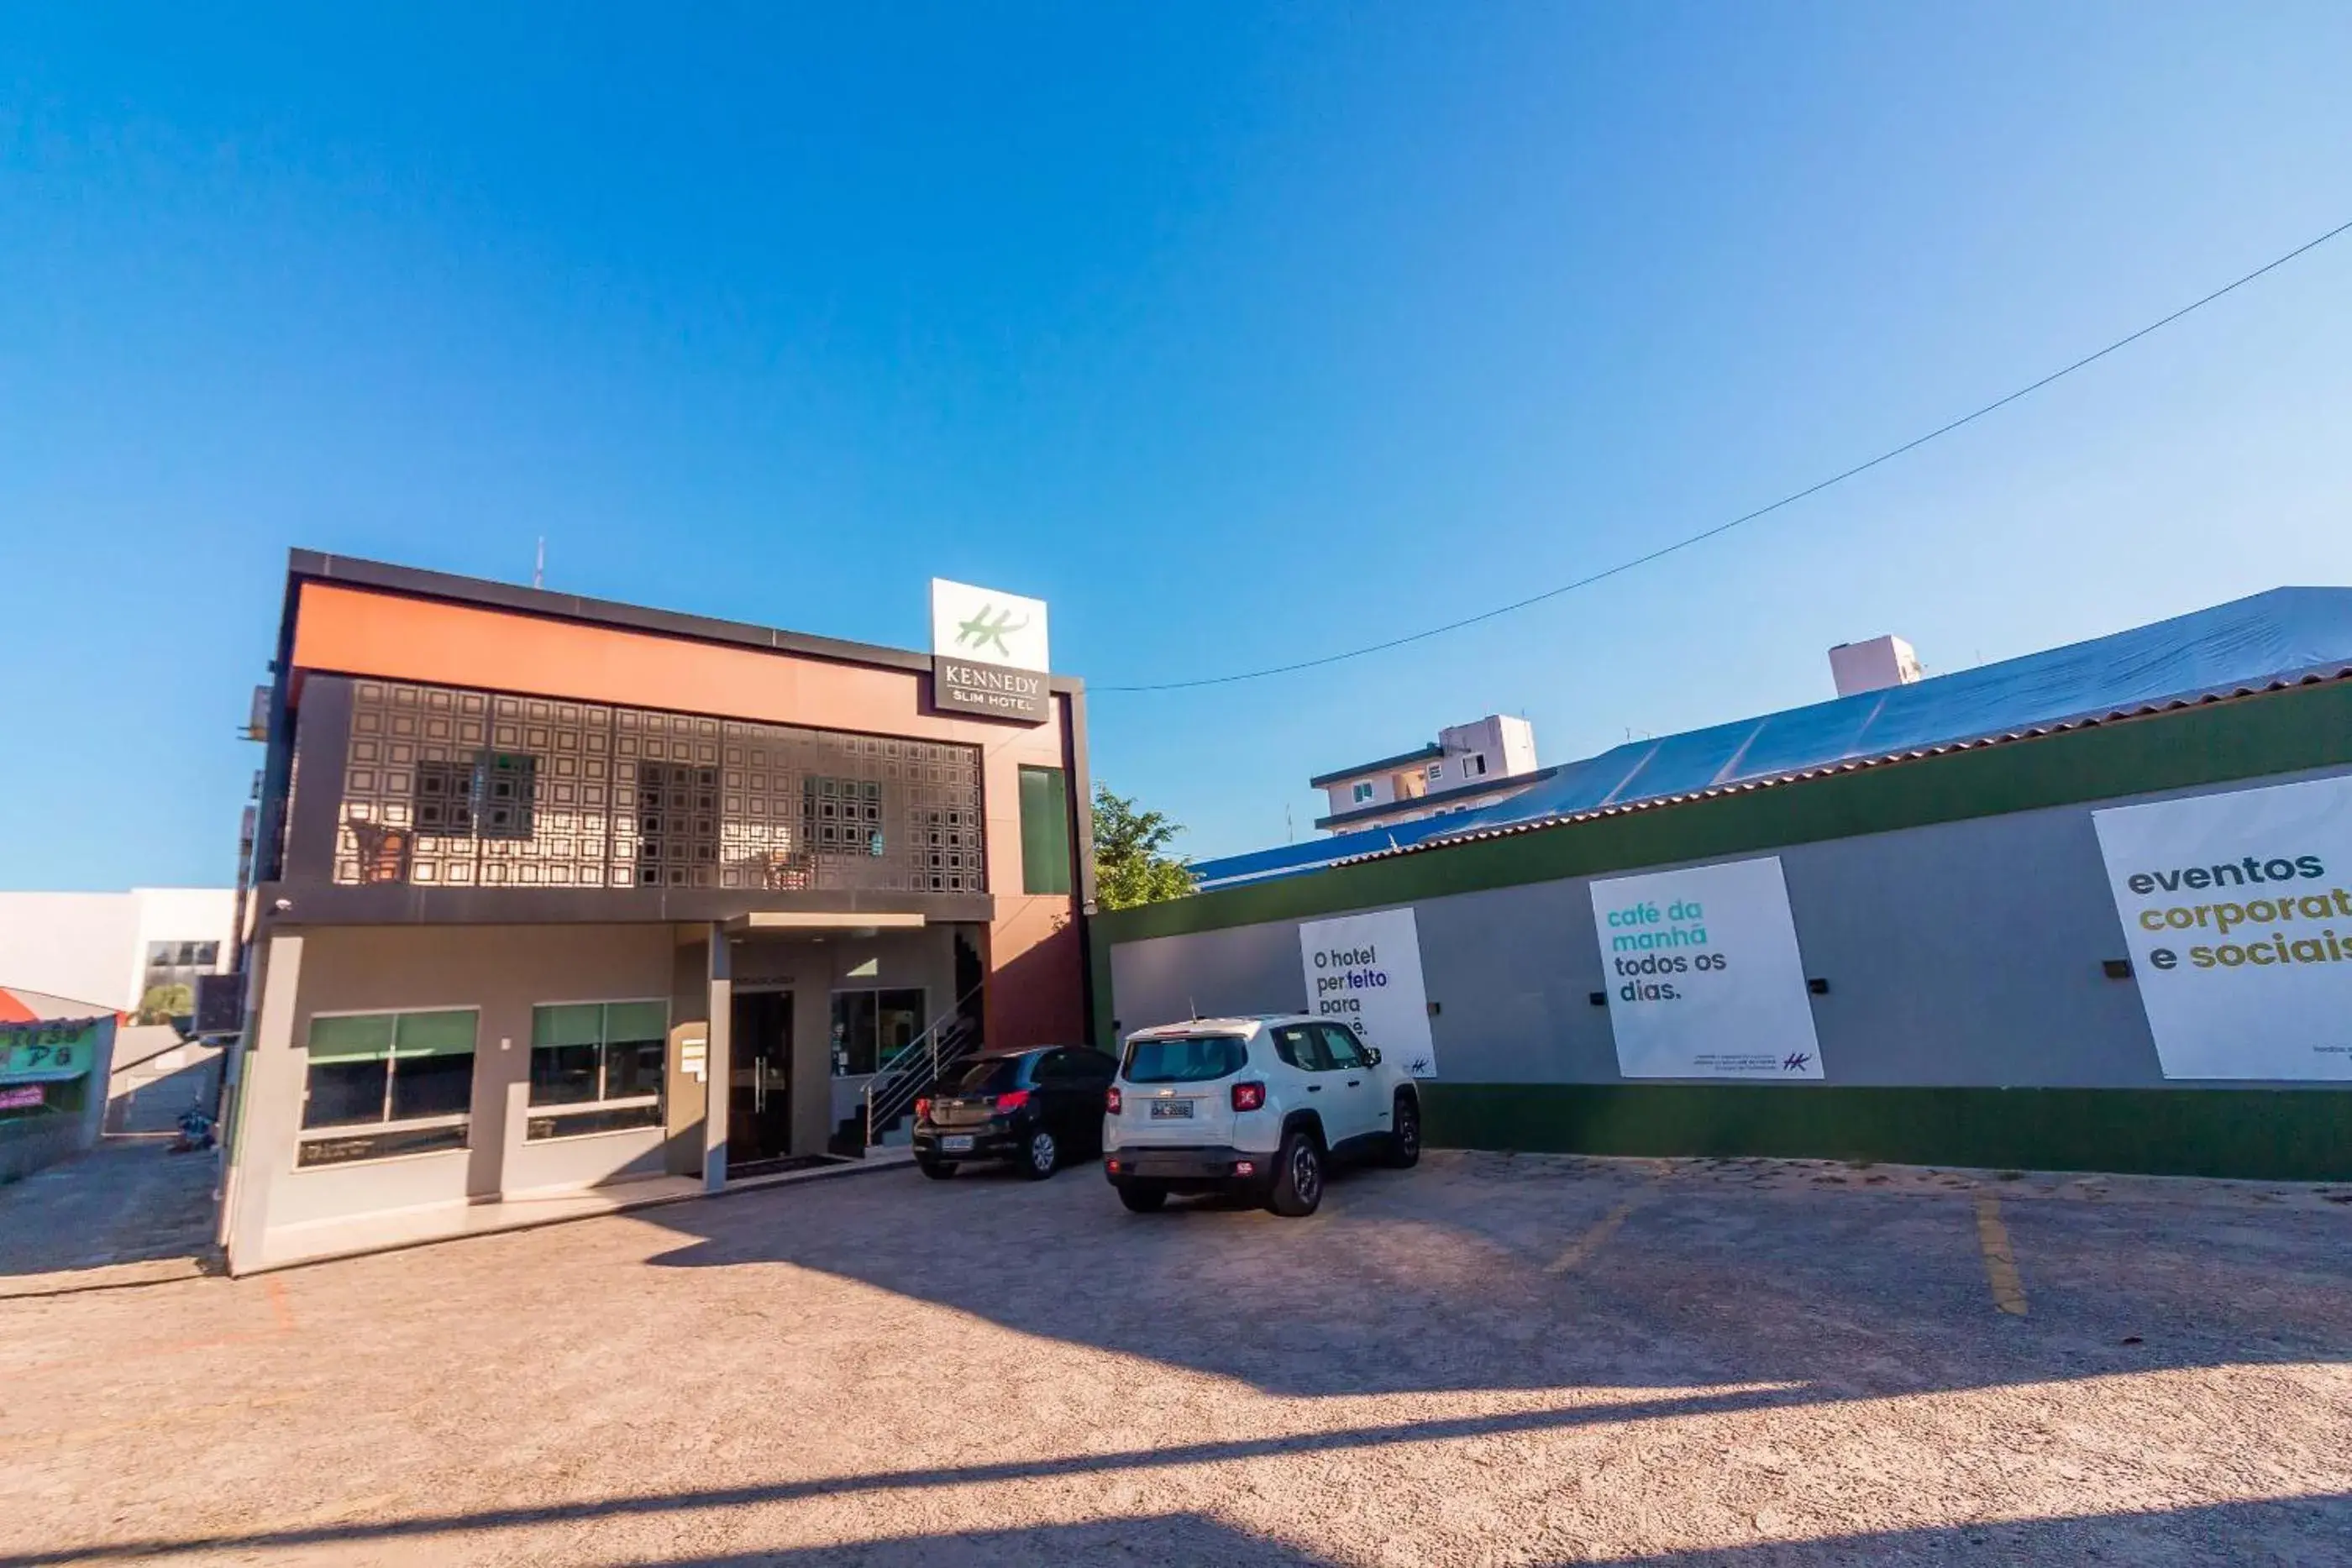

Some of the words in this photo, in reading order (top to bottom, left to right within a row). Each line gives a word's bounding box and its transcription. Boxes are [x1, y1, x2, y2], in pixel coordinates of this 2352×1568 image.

[946, 665, 1039, 695] KENNEDY
[952, 690, 984, 704] SLIM
[989, 695, 1035, 711] HOTEL
[2128, 855, 2325, 894] eventos
[1607, 900, 1661, 927] café
[1667, 898, 1704, 921] da
[2140, 888, 2352, 935] corporat
[1612, 923, 1708, 952] manhã
[1314, 952, 1327, 968] O
[1331, 945, 1377, 967] hotel
[1614, 953, 1688, 977] todos
[1694, 952, 1727, 972] os
[2150, 948, 2177, 970] e
[1316, 969, 1387, 997] perfeito
[1620, 979, 1681, 1002] dias.
[1320, 997, 1361, 1015] para
